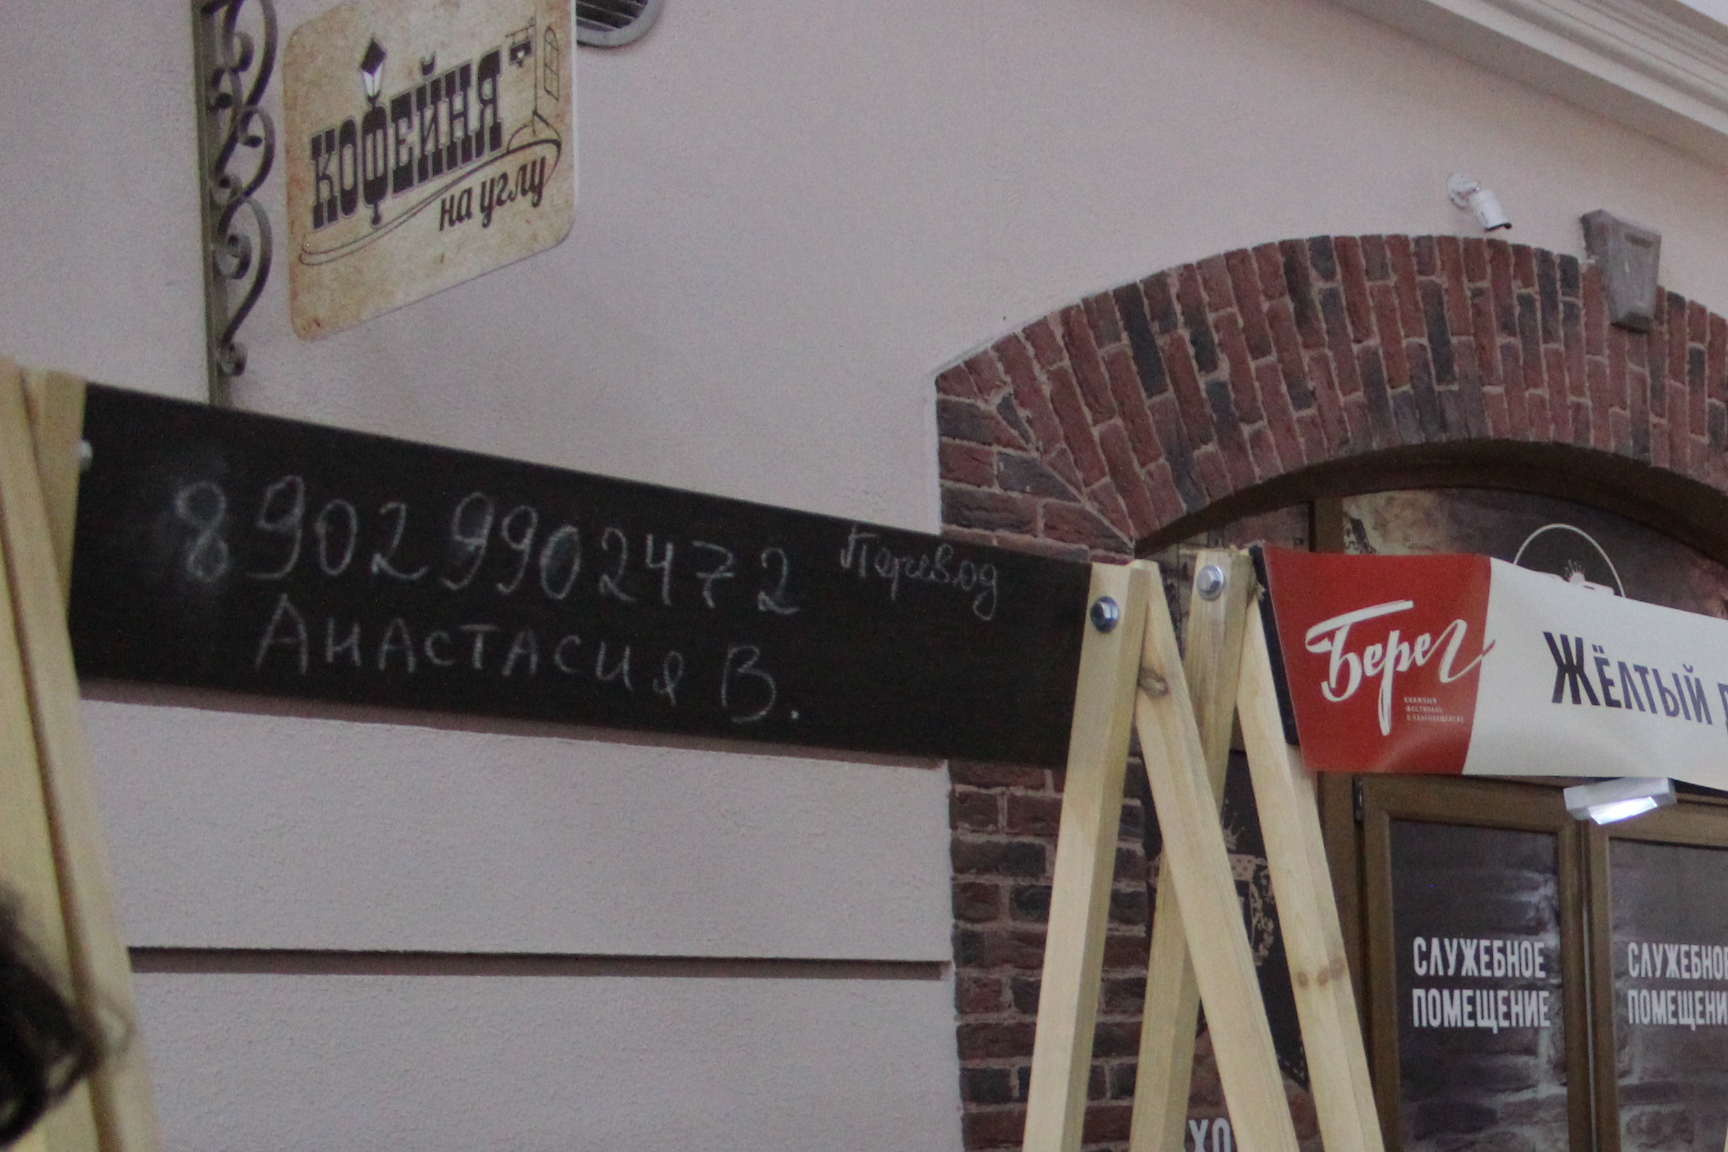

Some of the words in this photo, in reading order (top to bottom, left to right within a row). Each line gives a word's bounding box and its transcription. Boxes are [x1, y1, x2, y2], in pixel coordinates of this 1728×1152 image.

[309, 50, 505, 231] КОФЕЙНЯ
[438, 186, 475, 232] на
[477, 154, 547, 229] углу
[173, 482, 229, 585] 8
[1305, 600, 1496, 736] Берег
[1543, 631, 1713, 726] ЖЁЛТЫЙ
[1413, 936, 1546, 979] СЛУЖЕБНОЕ
[1412, 988, 1551, 1034] ПОМЕЩЕНИЕ
